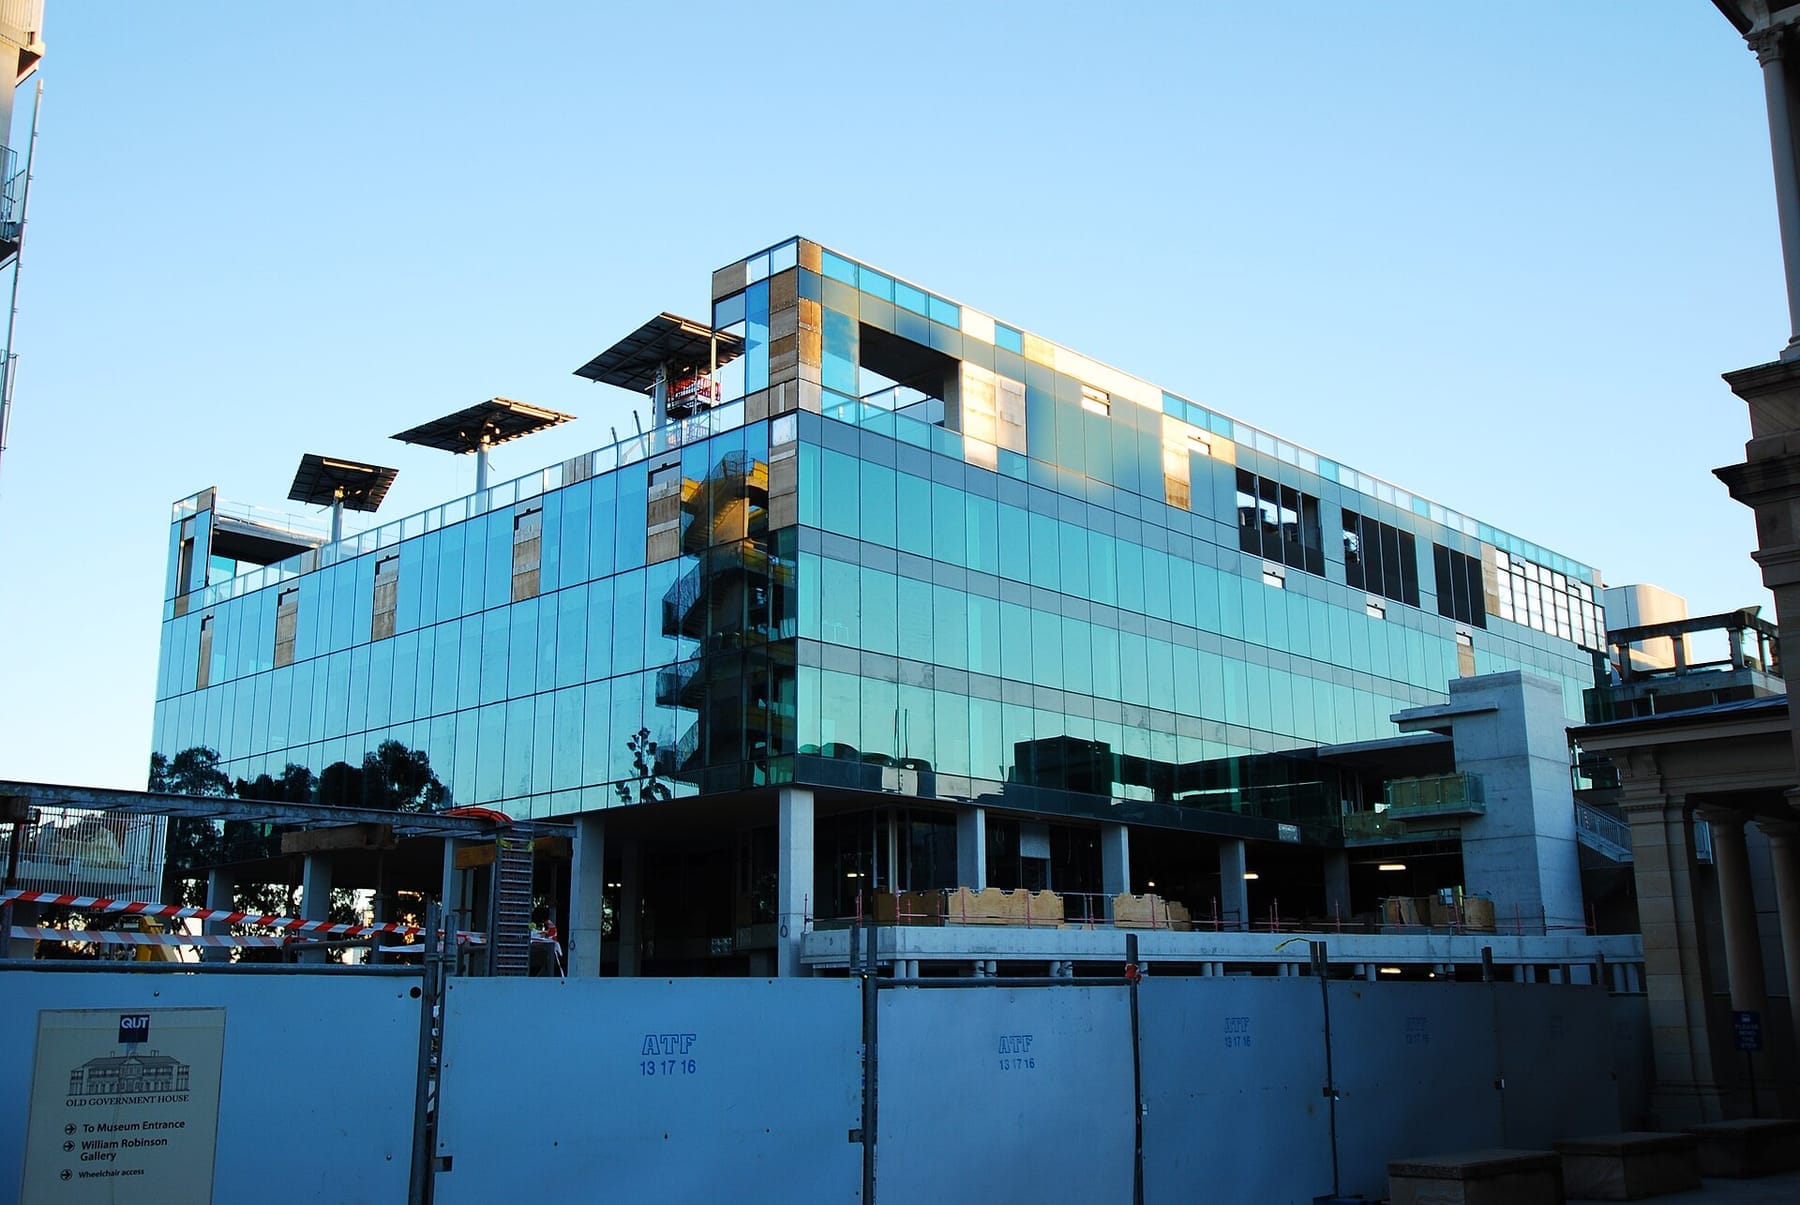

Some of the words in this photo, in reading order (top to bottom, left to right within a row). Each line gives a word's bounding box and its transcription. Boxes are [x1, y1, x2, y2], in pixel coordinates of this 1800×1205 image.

[120, 1017, 149, 1029] QUT
[641, 1033, 697, 1055] ATF
[999, 1034, 1033, 1054] ATF
[640, 1060, 656, 1076] 13
[661, 1059, 676, 1075] 17
[681, 1058, 696, 1074] 16
[1000, 1058, 1010, 1071] 13
[1012, 1058, 1022, 1069] 17
[1024, 1057, 1035, 1069] 16
[66, 1098, 87, 1107] OLD
[88, 1096, 156, 1106] GOVERNMENT
[158, 1094, 190, 1104] HOUSE
[83, 1124, 95, 1133] To
[97, 1122, 141, 1132] Museum
[142, 1120, 186, 1130] Entrance
[81, 1139, 119, 1150] William
[121, 1137, 168, 1148] Robinson
[80, 1151, 117, 1162] Gallery
[78, 1170, 120, 1179] Wheelchair
[121, 1168, 145, 1177] access
